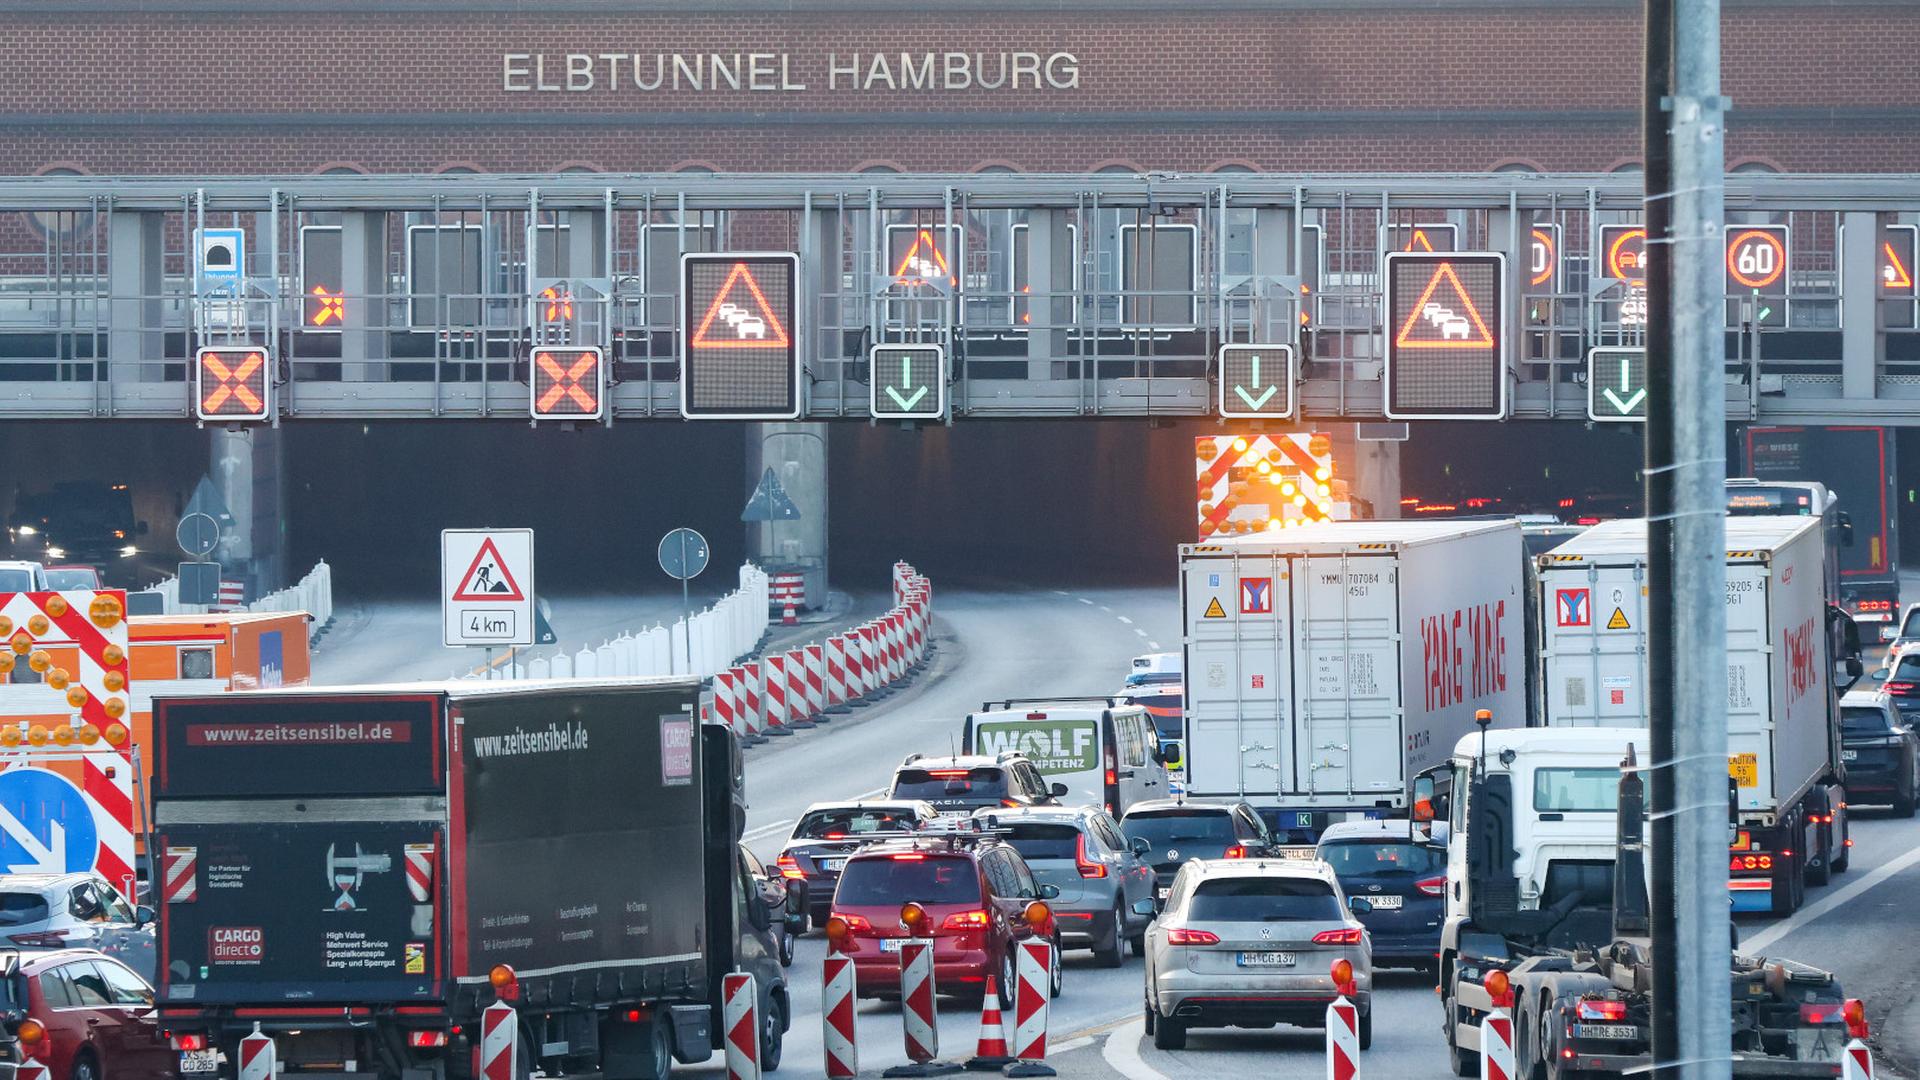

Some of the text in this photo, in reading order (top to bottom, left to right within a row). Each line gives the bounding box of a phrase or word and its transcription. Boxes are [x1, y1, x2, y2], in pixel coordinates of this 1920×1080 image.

[502, 52, 1080, 92] ELBTUNNEL HAMBURG
[1738, 243, 1774, 274] 60
[1320, 573, 1395, 584] YMMU 707084 0
[1348, 585, 1369, 597] 45G1
[1757, 580, 1763, 591] 4
[470, 613, 507, 633] 4 km
[204, 723, 393, 742] www.zeitsensibel.de
[474, 721, 588, 758] www.zeitsensibel.de
[981, 727, 1095, 759] WOLF
[1300, 814, 1309, 825] K
[1383, 896, 1402, 906] 3330
[214, 929, 261, 943] CARGO
[326, 931, 366, 941] High Value
[214, 943, 250, 956] direct
[326, 940, 389, 949] Mehrwert Service
[326, 950, 386, 960] Spezialkonzepte
[1243, 952, 1294, 964] HH CG 137
[326, 959, 396, 969] Lang- und Sperrgut
[1581, 1027, 1636, 1038] HH RE 3531
[1810, 1030, 1830, 1059] A
[196, 1060, 214, 1071] 285
